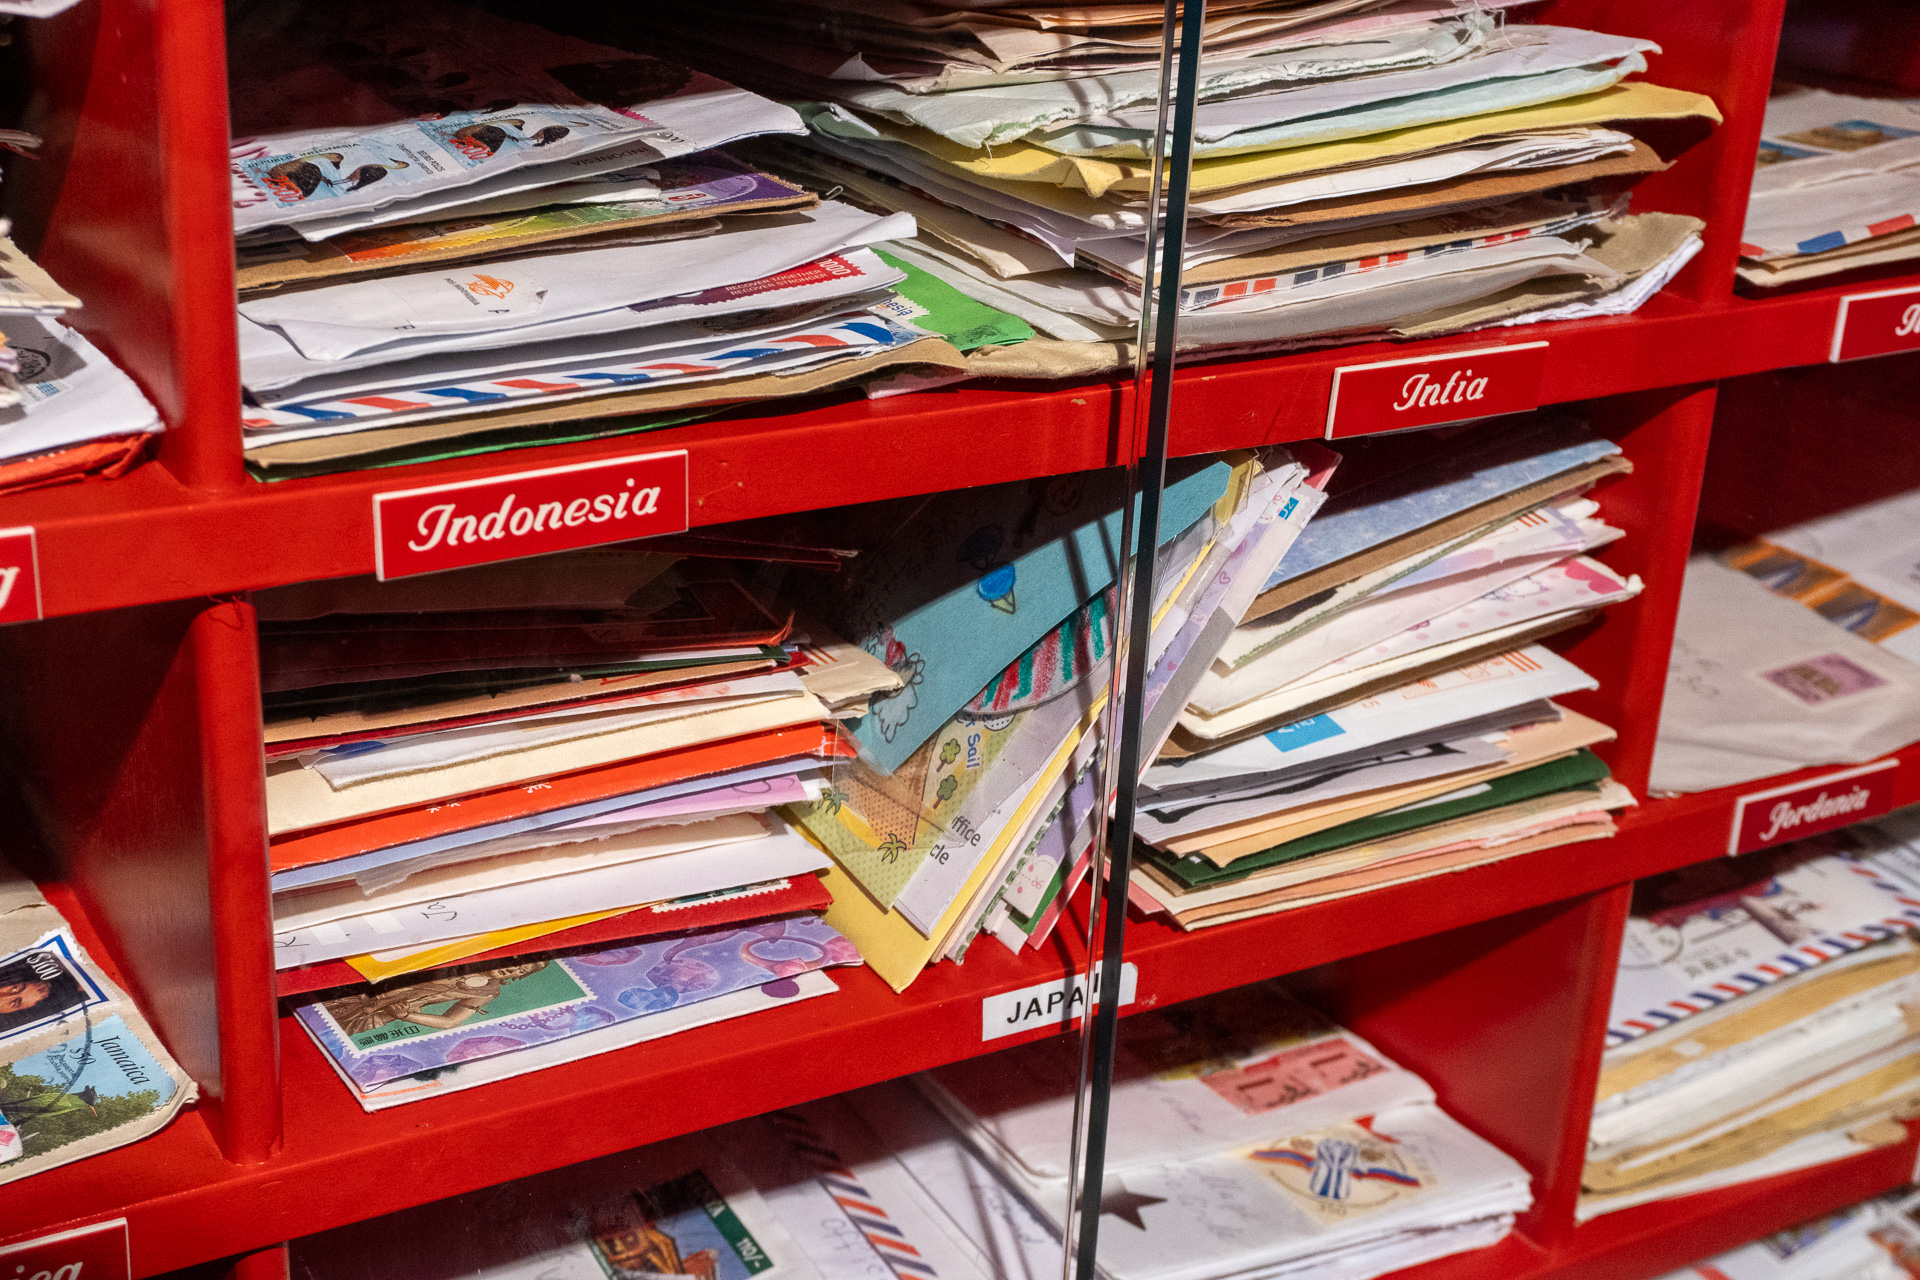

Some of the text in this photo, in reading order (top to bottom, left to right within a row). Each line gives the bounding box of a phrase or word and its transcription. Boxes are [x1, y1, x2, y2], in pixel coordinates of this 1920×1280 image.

[725, 269, 821, 292] RECOVER TOGETHER
[730, 273, 828, 296] RECOVER STRONGER
[1393, 369, 1489, 411] Intia
[407, 477, 661, 552] Indonesia
[965, 733, 981, 769] Sail
[951, 815, 981, 847] ffice
[1759, 785, 1871, 842] Jordania
[26, 952, 64, 980] $100
[1006, 972, 1100, 1024] JAPA
[70, 1047, 96, 1066] $50
[91, 1035, 151, 1086] Jamaica
